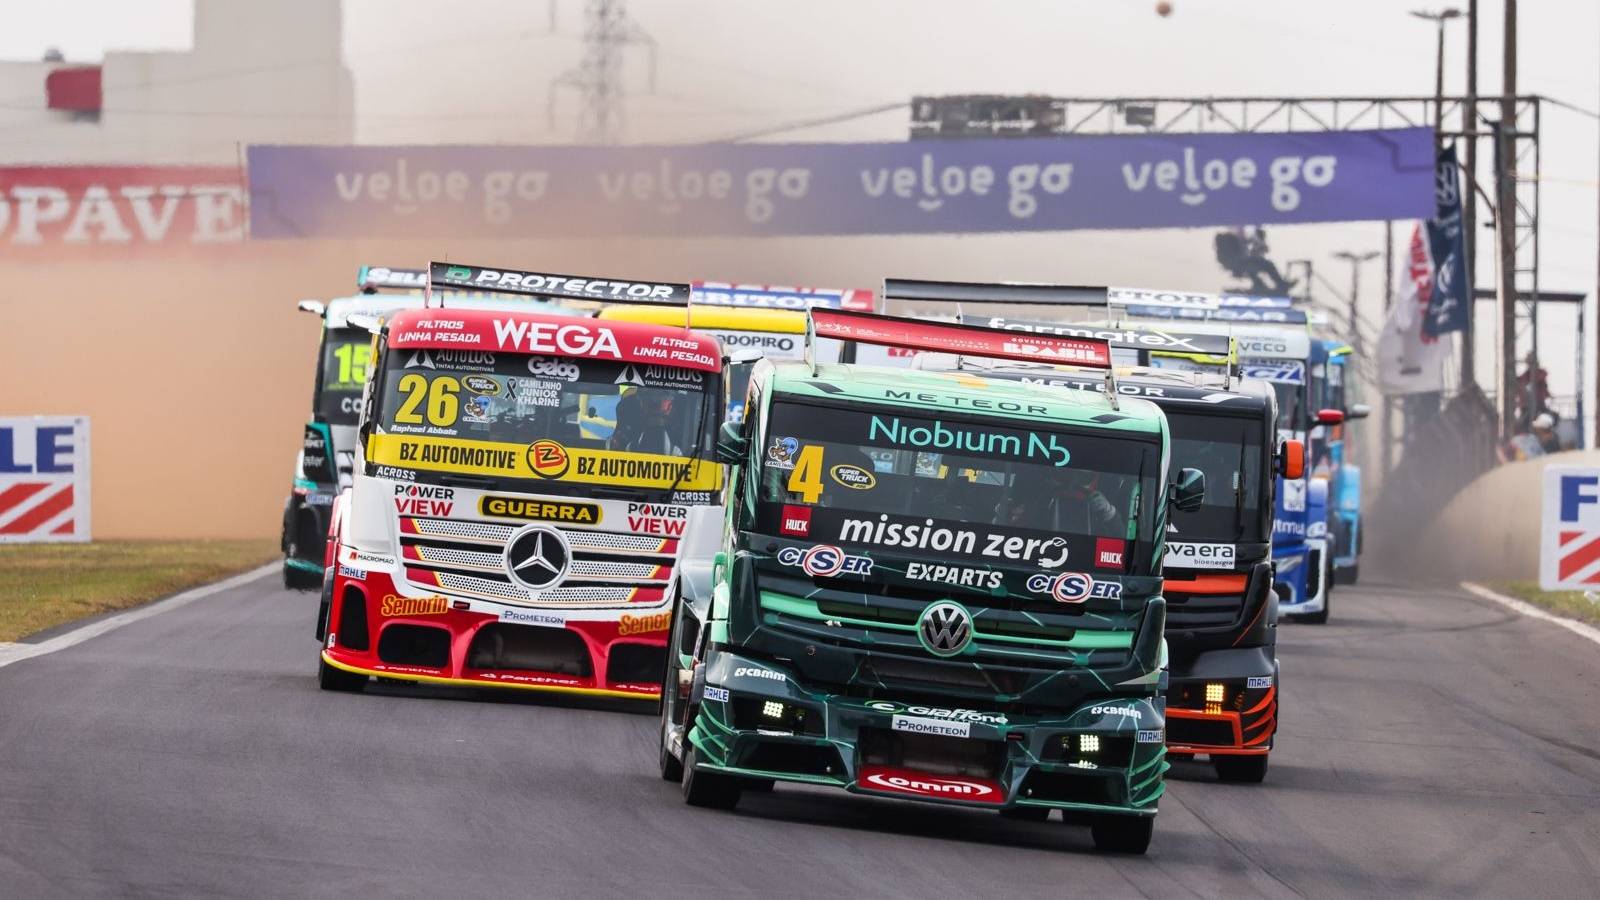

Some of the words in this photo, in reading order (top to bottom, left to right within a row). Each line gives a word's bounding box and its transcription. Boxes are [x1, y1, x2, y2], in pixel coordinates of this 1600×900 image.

[860, 153, 995, 199] veloe
[1008, 162, 1074, 218] go
[1121, 147, 1257, 194] veloe
[1269, 155, 1338, 212] go
[335, 158, 470, 202] veloe
[484, 169, 550, 225] go
[599, 157, 732, 202] veloe
[745, 167, 811, 224] go
[475, 269, 674, 298] PROTECTOR
[416, 320, 465, 329] FILTROS
[398, 332, 432, 342] LINHA
[433, 333, 481, 343] PESADA
[492, 317, 623, 359] WEGA
[652, 336, 699, 350] FILTROS
[1011, 337, 1054, 346] GOVERNO
[1056, 342, 1096, 350] FEDERAL
[633, 346, 668, 358] LINHA
[670, 352, 715, 366] PESADA
[1002, 342, 1105, 361] BRASIL
[518, 379, 562, 391] CAMILINHO
[520, 387, 558, 399] JUNIOR
[394, 373, 461, 427] 26
[517, 396, 560, 408] KHARINE
[885, 390, 1049, 415] METEOR
[391, 425, 426, 435] Raphael
[400, 443, 417, 462] BZ
[421, 444, 516, 469] AUTOMOTIVE
[376, 465, 416, 481] ACROSS
[577, 456, 596, 476] BZ
[598, 460, 692, 482] AUTOMOTIVE
[788, 445, 825, 504] 4
[838, 468, 860, 478] SUPER
[841, 474, 869, 484] TRUCK
[672, 491, 711, 502] ACROSS
[1560, 475, 1598, 522] F
[394, 498, 454, 517] VIEW
[488, 499, 593, 521] GUERRA
[627, 516, 687, 536] VIEW
[785, 519, 808, 532] HUCK
[839, 513, 977, 554] mission
[982, 533, 1069, 569] zero
[1100, 551, 1122, 565] HUCK
[1199, 545, 1234, 558] era
[778, 546, 874, 576] CISER
[1194, 559, 1233, 567] bioenergia
[341, 566, 366, 579] MAHLE
[905, 562, 1004, 589] EXPARTS
[1026, 572, 1123, 602] CISER
[381, 594, 449, 616] Semorin
[504, 610, 564, 625] PROMETEON
[908, 706, 1009, 724] Giaffone
[896, 719, 967, 736] PROMETEON
[1138, 730, 1163, 743] MAHLE
[888, 777, 972, 793] omni
